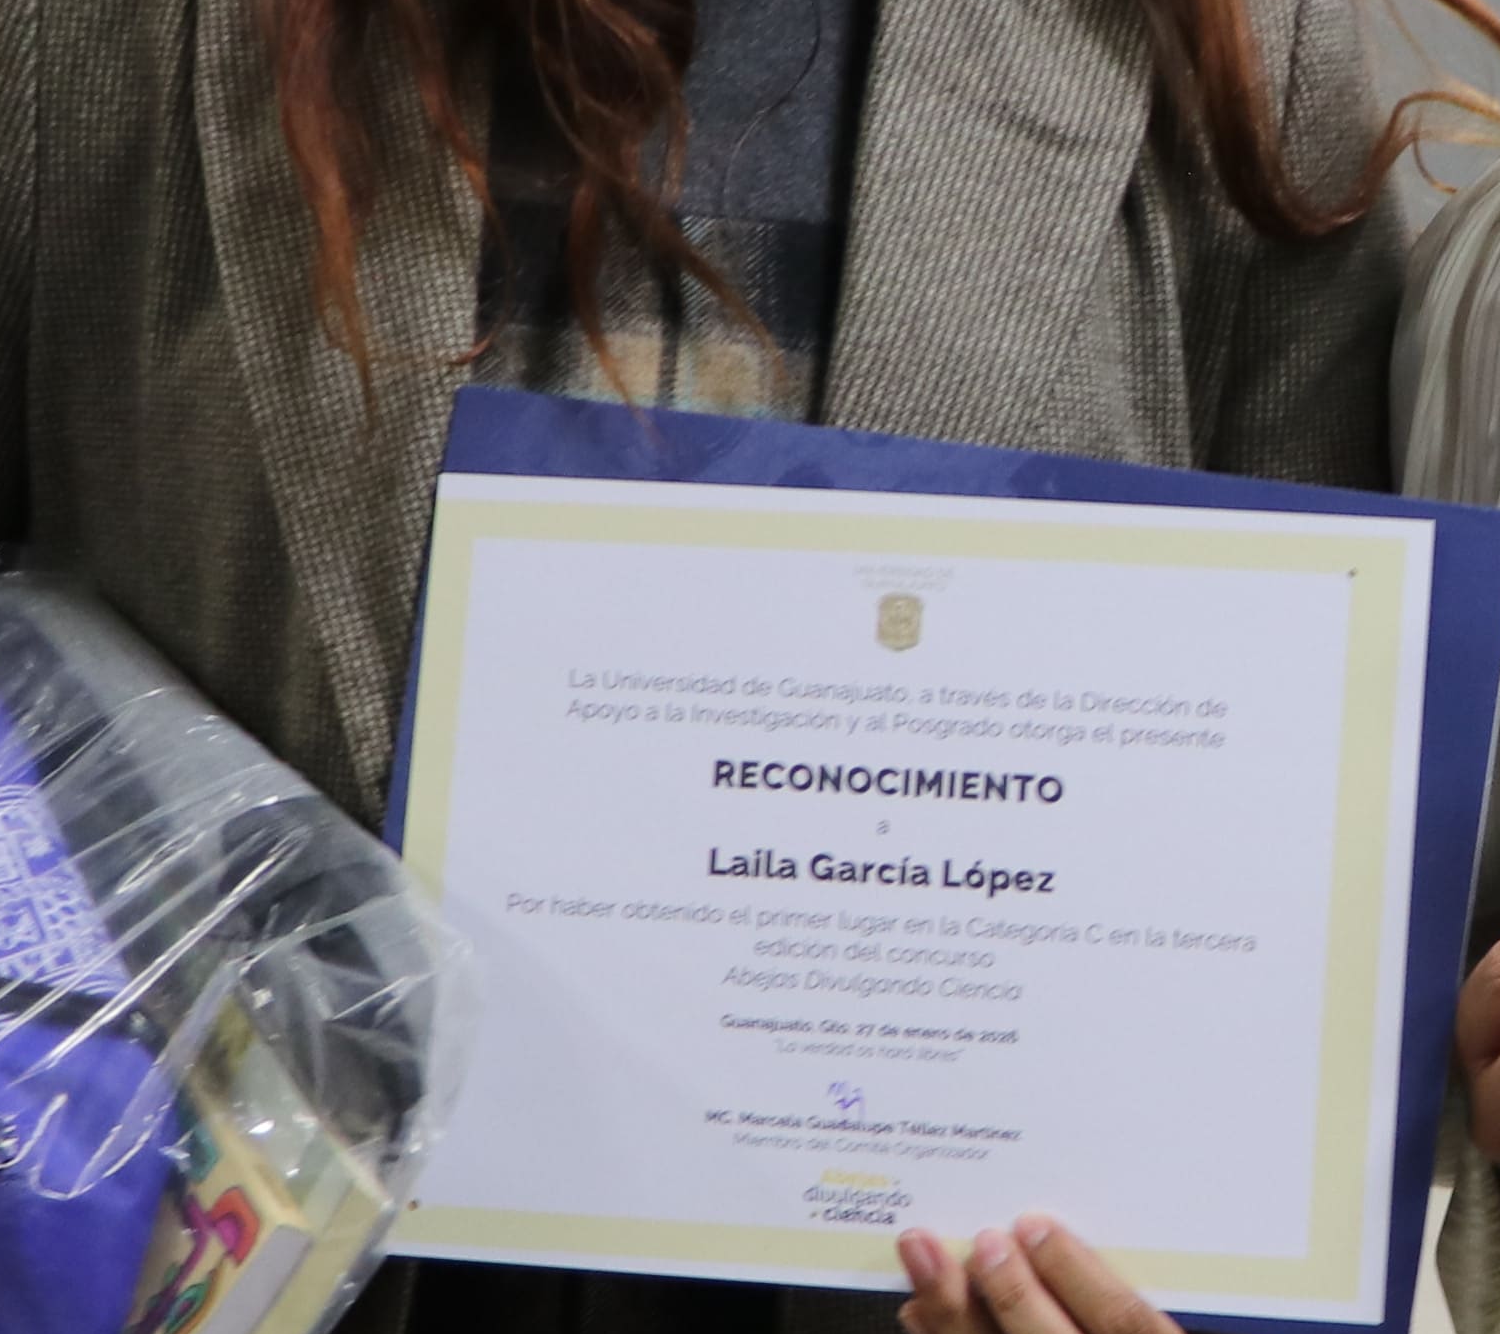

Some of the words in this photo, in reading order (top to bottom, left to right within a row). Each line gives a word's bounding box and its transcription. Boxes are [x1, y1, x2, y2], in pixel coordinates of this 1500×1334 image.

[568, 669, 597, 689] La
[602, 671, 737, 695] Universidad
[741, 677, 773, 697] de
[918, 689, 934, 704] a
[939, 686, 1010, 708] través
[1016, 689, 1047, 710] de
[1053, 690, 1075, 711] la
[1080, 691, 1190, 716] Dirección
[1195, 698, 1228, 718] de
[566, 699, 640, 724] Apoyo
[645, 705, 660, 722] a
[664, 702, 686, 723] la
[691, 704, 840, 732] Investigación
[846, 715, 861, 736] y
[865, 712, 887, 733] al
[892, 712, 1004, 740] Posgrado
[1008, 720, 1087, 746] otorga
[1091, 723, 1114, 743] el
[1119, 728, 1226, 749] presente
[713, 760, 1063, 803] RECONOCIMIENTO
[876, 820, 890, 835] a
[709, 848, 798, 880] Laila
[809, 853, 930, 886] García
[942, 860, 1054, 898] López
[506, 892, 551, 914] Por
[550, 897, 616, 918] haber
[621, 900, 724, 924] obtenido
[728, 905, 751, 925] el
[756, 910, 833, 930] primer
[837, 910, 900, 938] lugar
[903, 918, 933, 935] en
[939, 916, 961, 937] la
[965, 917, 1079, 946] Categoría
[1084, 923, 1103, 944] C
[1108, 929, 1140, 946] en
[1145, 926, 1167, 948] la
[1172, 929, 1257, 953] tercera
[753, 938, 838, 959] edición
[843, 942, 882, 962] del
[886, 947, 995, 968] concurso
[721, 966, 799, 992] Abejas
[803, 969, 933, 999] Divulgando
[938, 977, 1023, 1001] Ciencia
